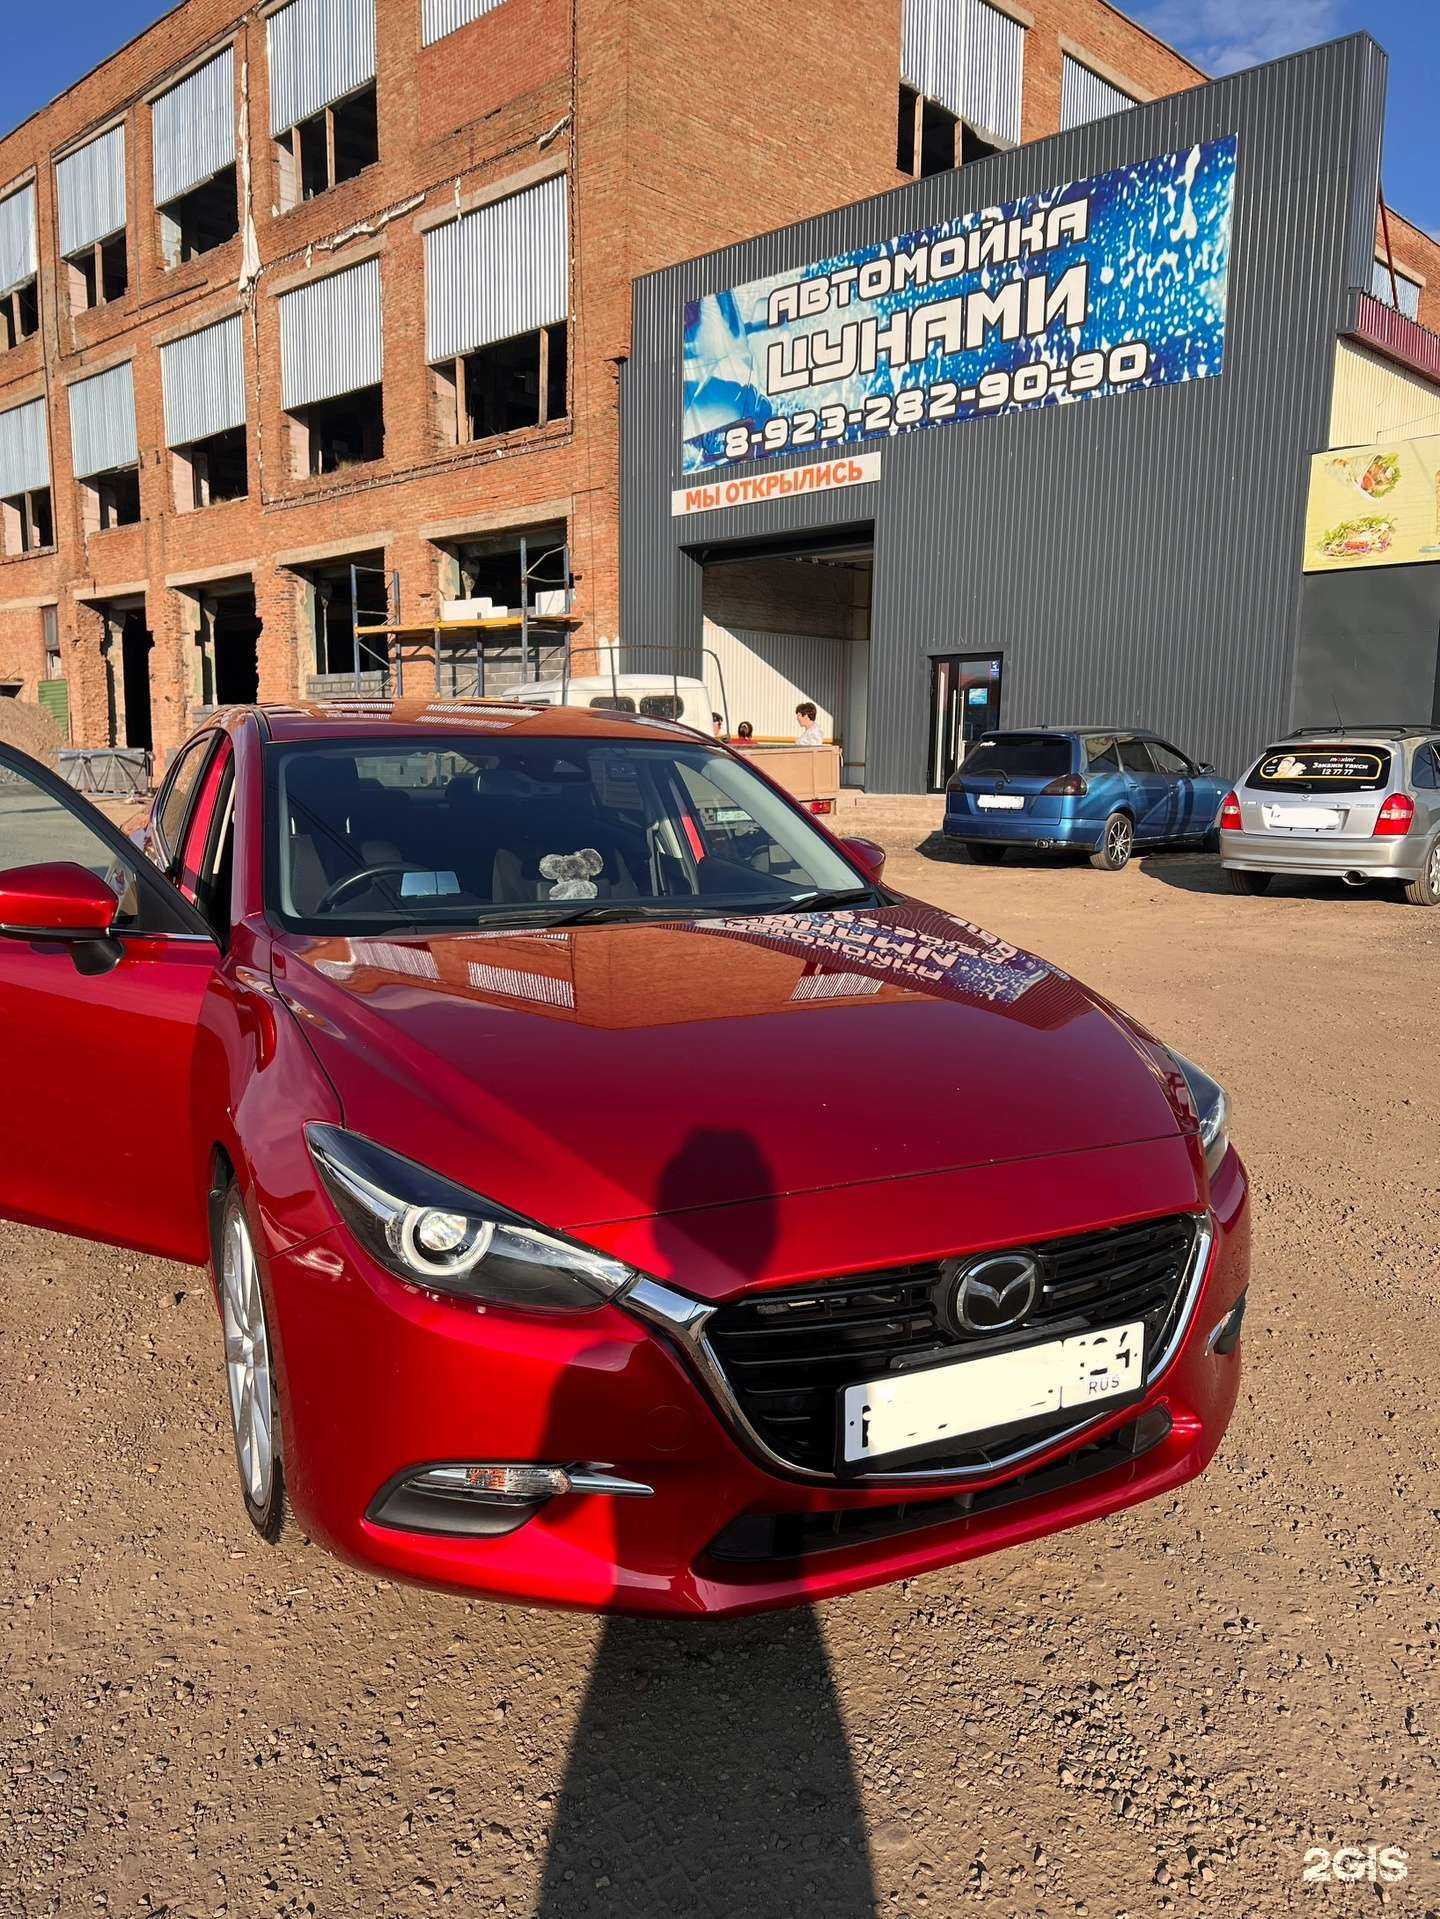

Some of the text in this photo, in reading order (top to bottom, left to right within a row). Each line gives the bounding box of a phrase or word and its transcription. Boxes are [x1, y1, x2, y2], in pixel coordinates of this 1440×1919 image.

[767, 197, 1090, 328] АВТОМОЙКА
[766, 263, 1090, 396] ЦУНАМИ
[725, 342, 1149, 461] 8-923-282-90-90
[685, 460, 863, 512] МЫ ОТКРЫЛИСЬ
[1088, 1376, 1120, 1395] RUS
